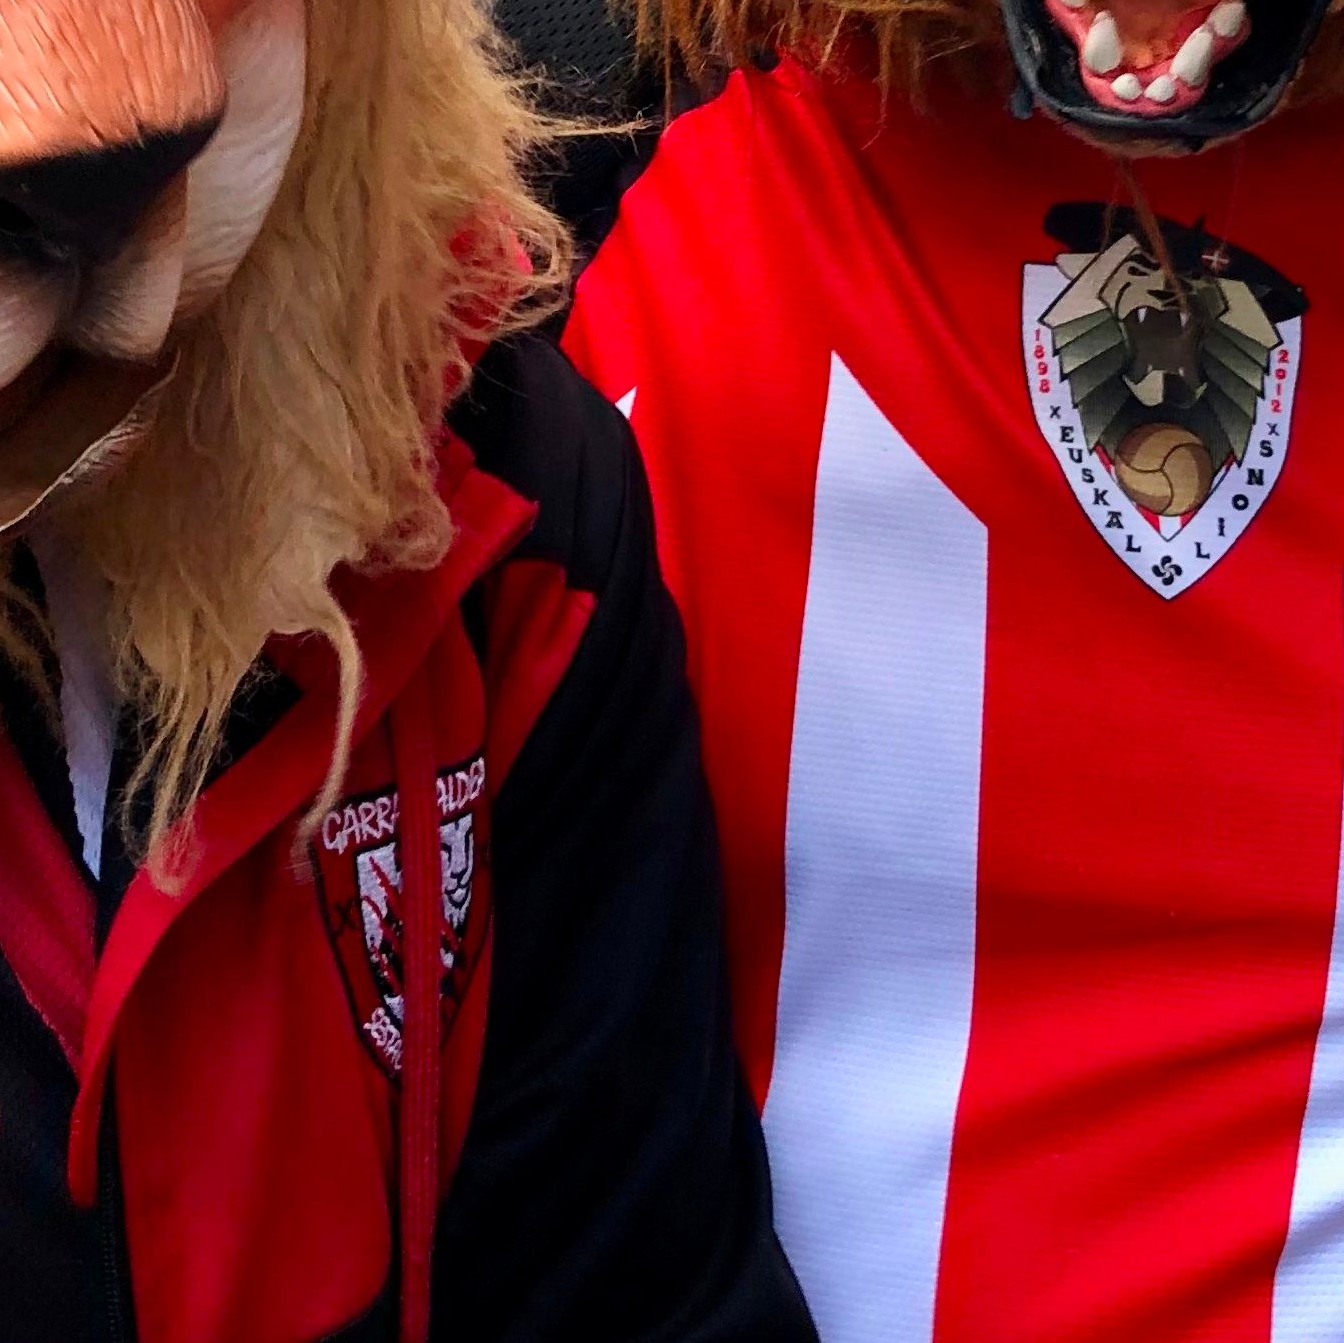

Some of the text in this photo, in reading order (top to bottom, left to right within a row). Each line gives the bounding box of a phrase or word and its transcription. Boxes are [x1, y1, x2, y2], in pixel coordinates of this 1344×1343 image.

[1032, 328, 1051, 395] 1898
[1059, 424, 1142, 554] EUSKAL
[1194, 439, 1275, 560] LIONS
[1270, 348, 1290, 414] 2012
